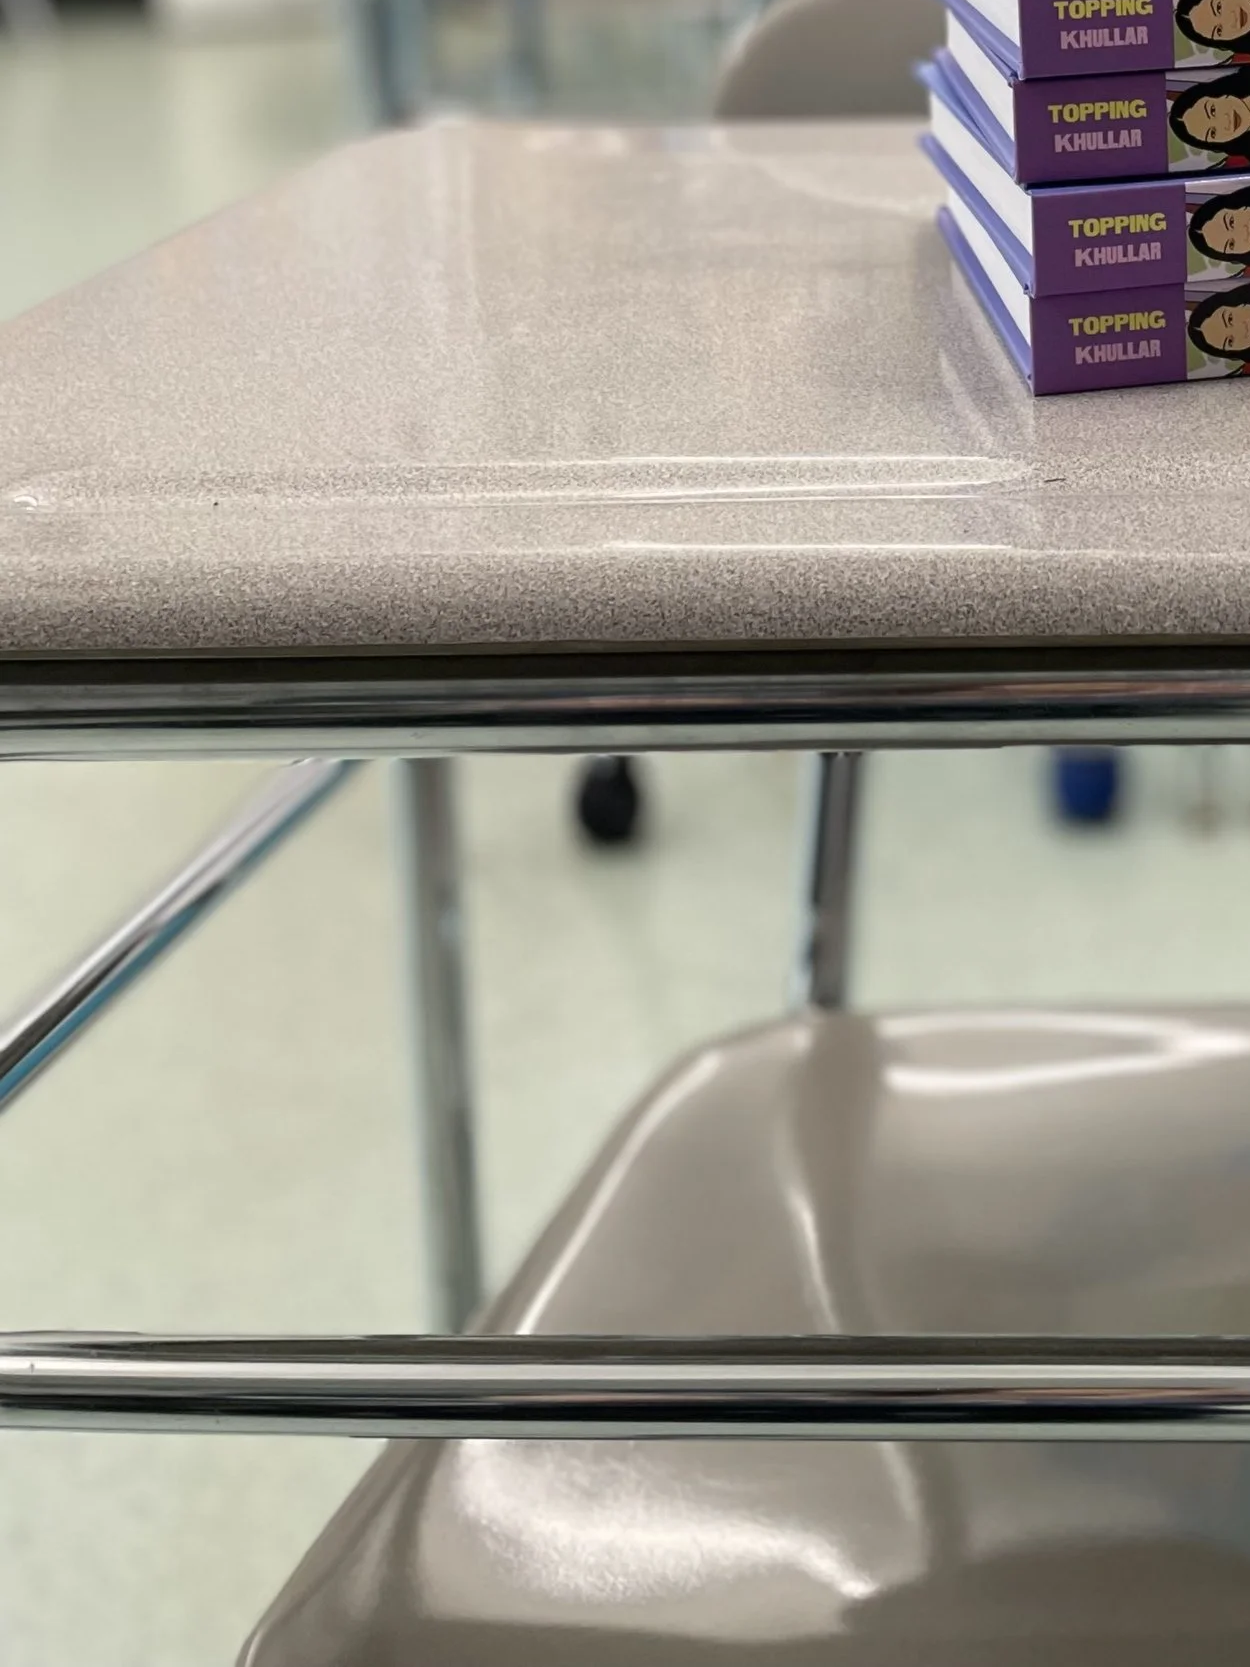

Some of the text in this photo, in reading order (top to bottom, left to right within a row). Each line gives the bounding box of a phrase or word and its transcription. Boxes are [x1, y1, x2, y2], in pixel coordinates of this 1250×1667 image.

[1060, 26, 1149, 50] KHULLAR
[1048, 99, 1147, 124] TOPPING
[1054, 128, 1143, 153] KHULLAR
[1068, 212, 1167, 238] TOPPING
[1074, 242, 1162, 267] KHULLAR
[1068, 310, 1166, 336] TOPPING
[1075, 339, 1161, 364] KHULLAR
